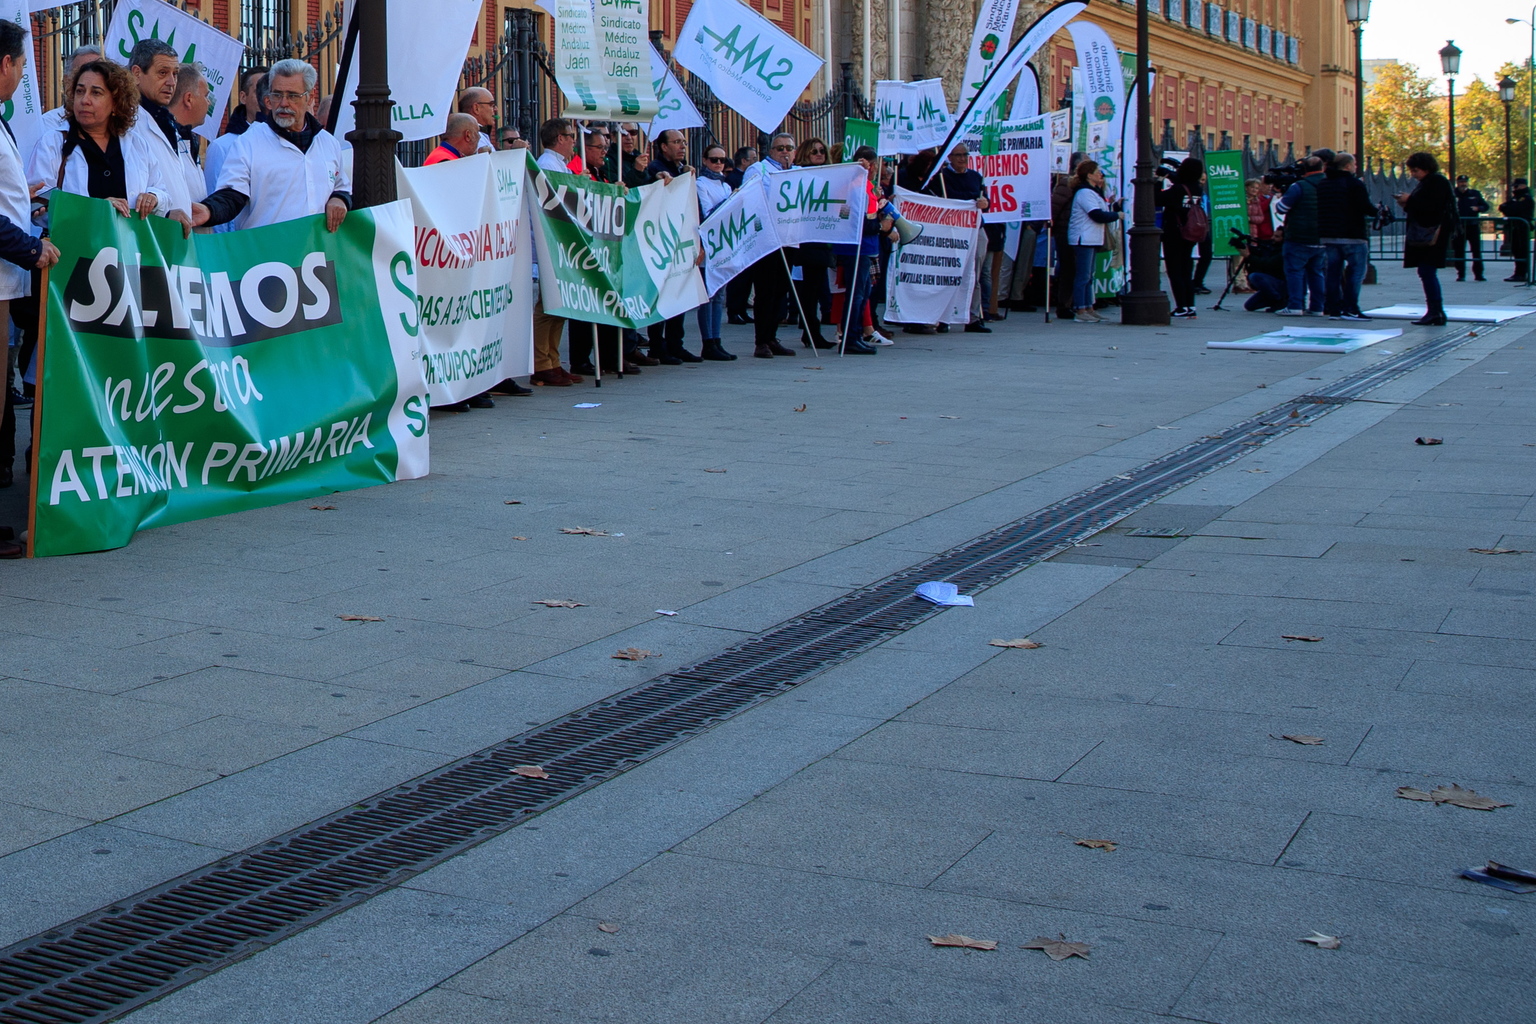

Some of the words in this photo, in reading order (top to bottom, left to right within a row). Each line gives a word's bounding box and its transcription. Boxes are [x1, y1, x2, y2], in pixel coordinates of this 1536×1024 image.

[558, 6, 587, 19] Sindicato
[561, 22, 587, 34] Médico
[601, 16, 641, 30] Sindicato
[561, 38, 590, 50] Andaluz
[605, 31, 638, 45] Médico
[604, 46, 641, 60] Andaluz
[565, 52, 590, 70] Jaén
[607, 61, 638, 78] Jaén
[22, 73, 34, 114] Sindicato
[1007, 136, 1044, 151] PRIMARIA
[1209, 164, 1238, 177] SMA
[776, 177, 847, 215] SMA
[986, 179, 1019, 214] ÁS
[815, 221, 836, 231] Jaén
[816, 215, 841, 225] Andaluz
[707, 207, 756, 260] SMA
[935, 237, 970, 251] ADECUADAS
[900, 252, 925, 266] ONTRATOS
[925, 255, 962, 268] ATRACTIVOS
[900, 271, 923, 284] ANTILLAS
[923, 273, 936, 286] BIEN
[105, 355, 264, 428] nuestra
[49, 429, 195, 506] ATENCIÓN
[201, 412, 375, 486] PRIMARIA
